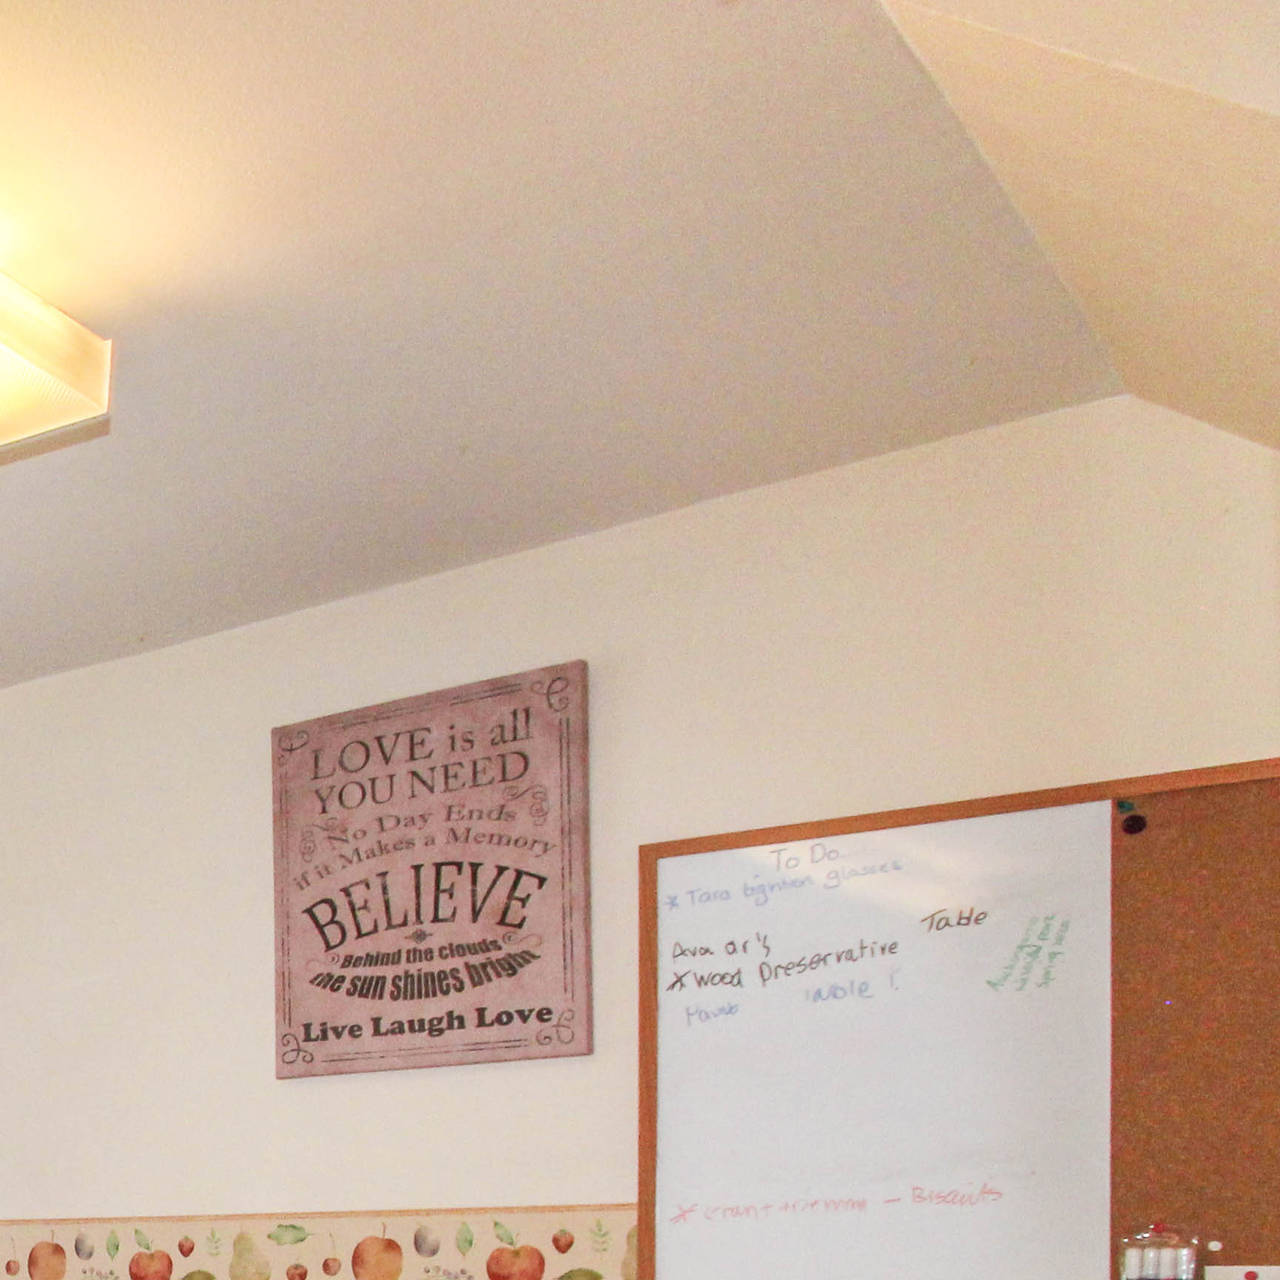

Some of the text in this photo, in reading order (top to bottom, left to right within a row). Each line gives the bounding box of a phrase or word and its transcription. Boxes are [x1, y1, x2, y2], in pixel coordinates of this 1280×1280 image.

[310, 706, 534, 781] LOVE is all
[314, 751, 531, 815] YOU NEED
[327, 804, 518, 850] No Day Ends
[338, 835, 417, 869] Makes
[423, 835, 437, 847] a
[444, 826, 560, 858] Memory
[769, 842, 840, 872] To Do
[302, 861, 548, 953] BELIEVE
[340, 938, 503, 969] Behind the clouds
[345, 972, 388, 1000] sun
[389, 966, 466, 1001] shines
[464, 949, 542, 988] bright
[301, 1006, 554, 1043] Live Laugh Love
